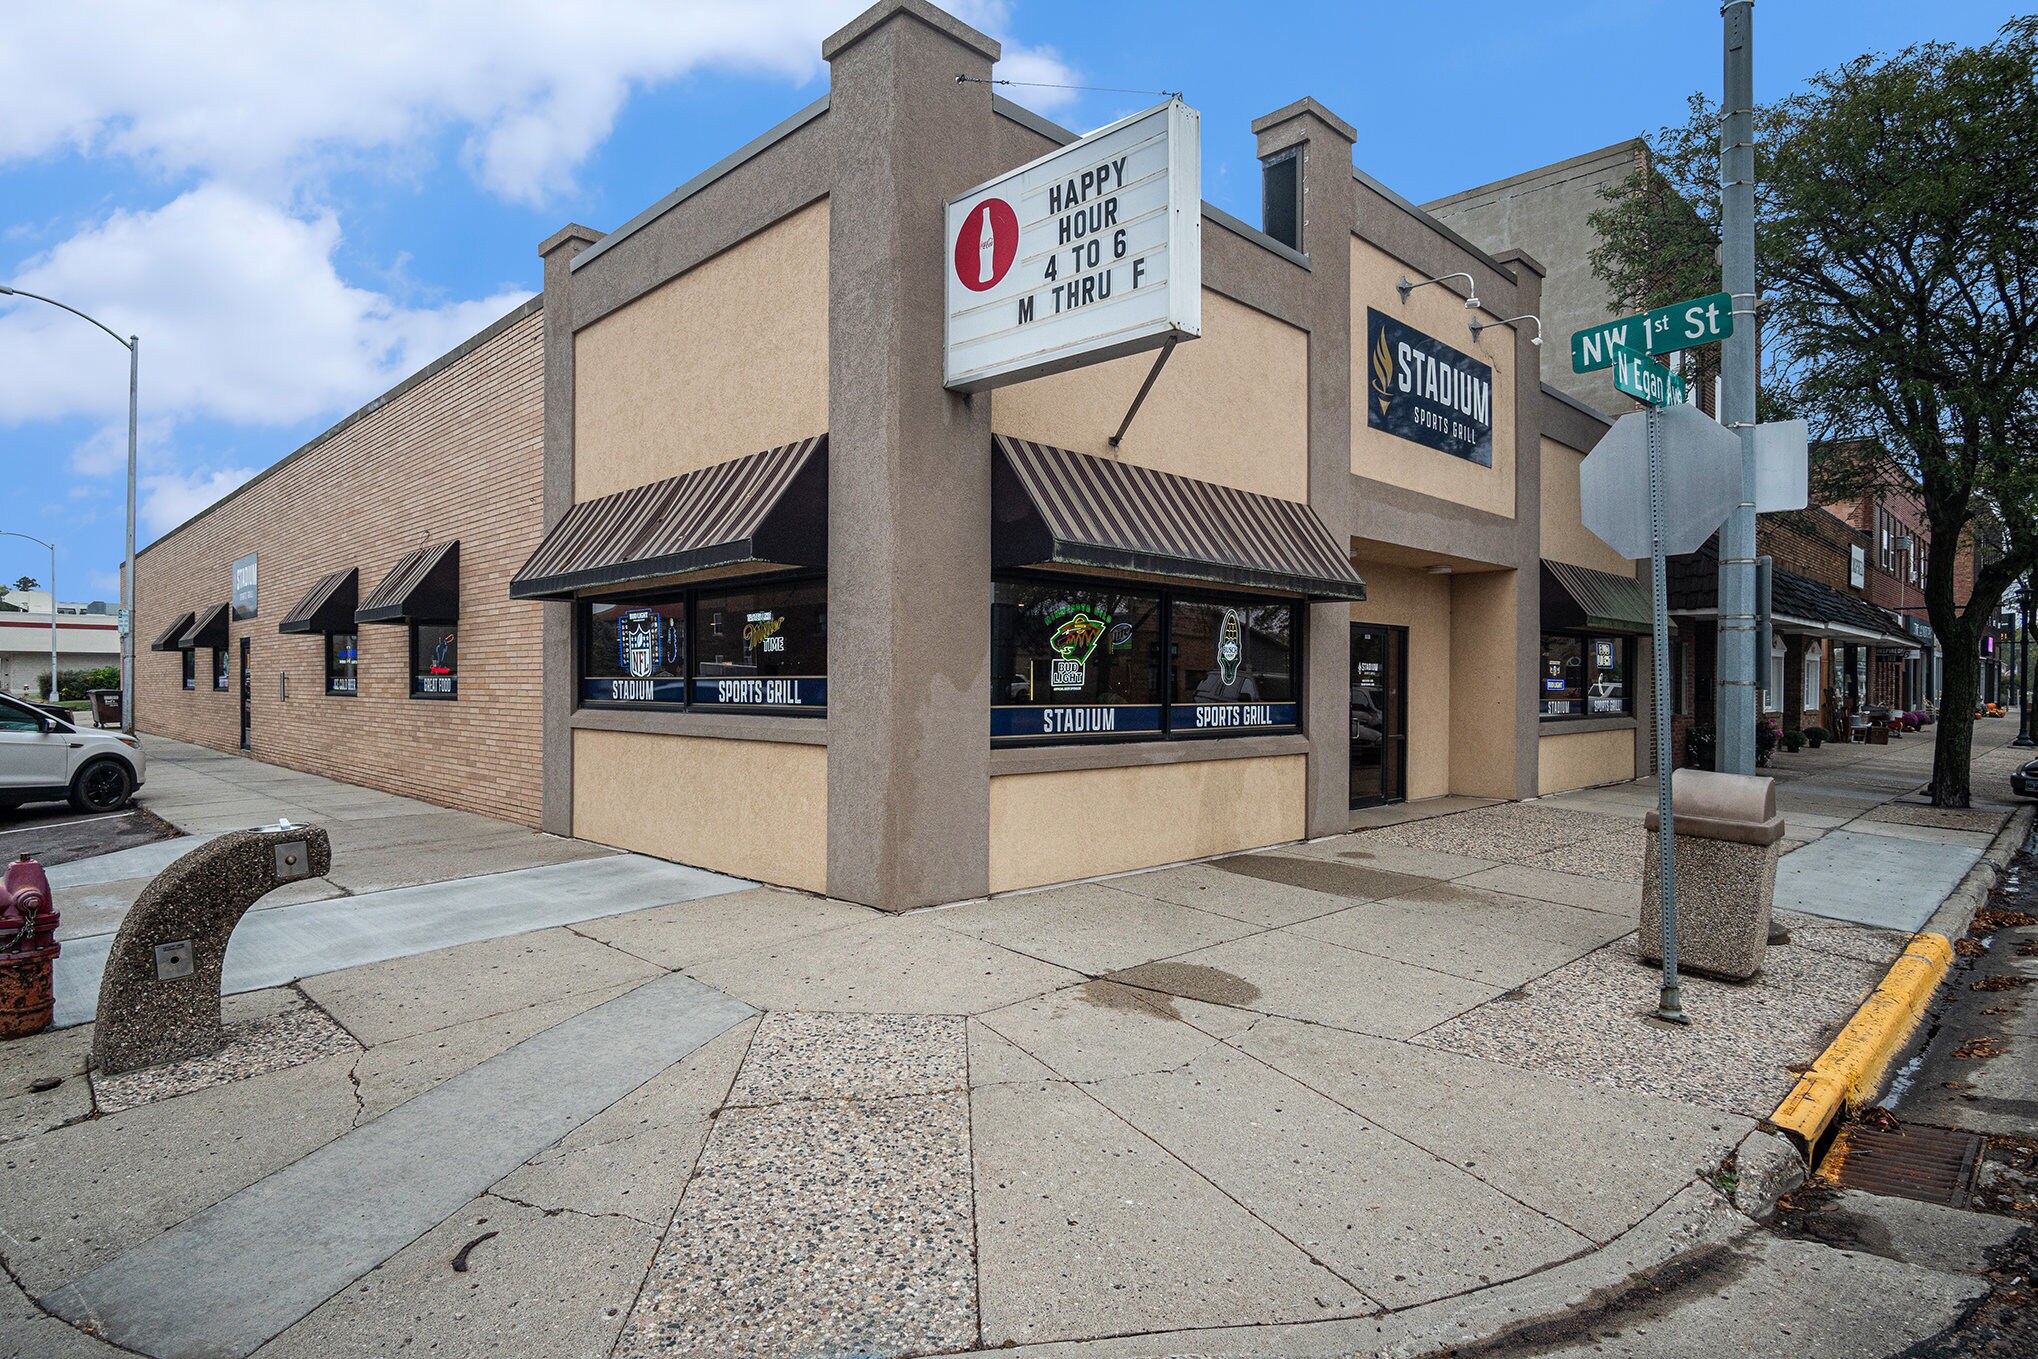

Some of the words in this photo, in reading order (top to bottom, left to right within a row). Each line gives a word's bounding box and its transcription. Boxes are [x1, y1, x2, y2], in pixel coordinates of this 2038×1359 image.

[1049, 156, 1128, 215] HAPPY
[1058, 197, 1118, 245] HOUR
[1044, 255, 1057, 281] 4
[1071, 239, 1100, 273] TO
[1113, 228, 1126, 259] 6
[1018, 295, 1034, 325] M
[1051, 269, 1111, 313] THRU
[1132, 258, 1145, 289] F
[1582, 325, 1627, 366] NW
[1643, 314, 1670, 350] 1st
[1684, 302, 1721, 339] St
[1398, 341, 1489, 427] STADIUM
[1618, 350, 1628, 386] N
[1634, 357, 1664, 401] Egan
[1667, 375, 1683, 406] Ave
[1414, 406, 1449, 434] SPORTS
[1452, 421, 1477, 445] GRILL
[763, 636, 784, 652] TIME
[632, 651, 649, 674] NFL
[1058, 662, 1079, 673] BUD
[423, 678, 438, 692] GREAT
[438, 678, 452, 692] FOOD
[612, 680, 654, 700] STADIUM
[1053, 672, 1083, 684] LIGHT
[718, 680, 762, 703] SPORTS
[766, 680, 802, 704] GRILL
[1196, 706, 1240, 727] SPORTS
[1243, 705, 1272, 725] GRILL
[1547, 701, 1570, 714] STADIUM
[1043, 708, 1115, 733] STADIUM
